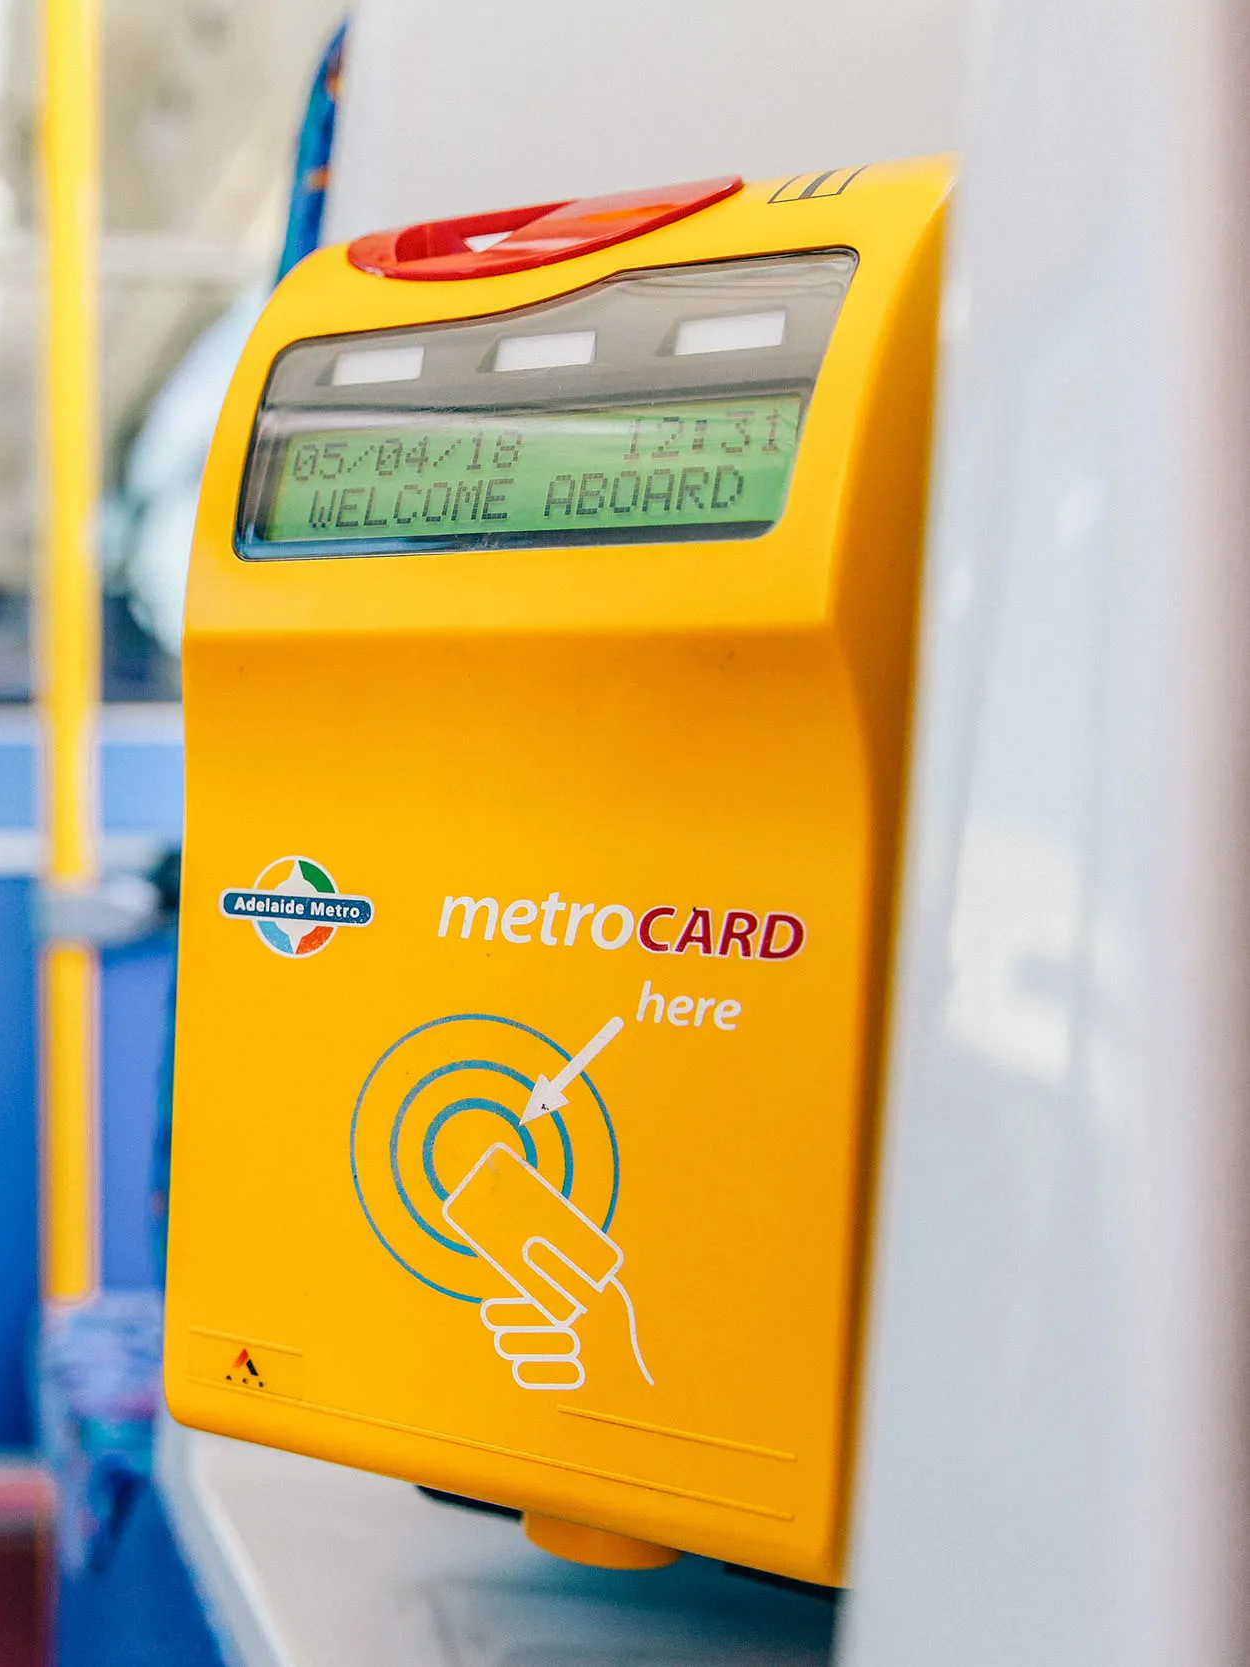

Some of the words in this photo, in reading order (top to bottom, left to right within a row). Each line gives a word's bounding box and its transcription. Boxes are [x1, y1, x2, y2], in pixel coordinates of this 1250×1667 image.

[293, 431, 523, 481] 05/04/18
[623, 407, 782, 462] 12:31
[309, 478, 514, 530] WELCOME
[545, 464, 744, 518] ABOARD
[234, 896, 305, 915] Adelaide
[310, 901, 360, 918] Metro
[637, 981, 742, 1030] here
